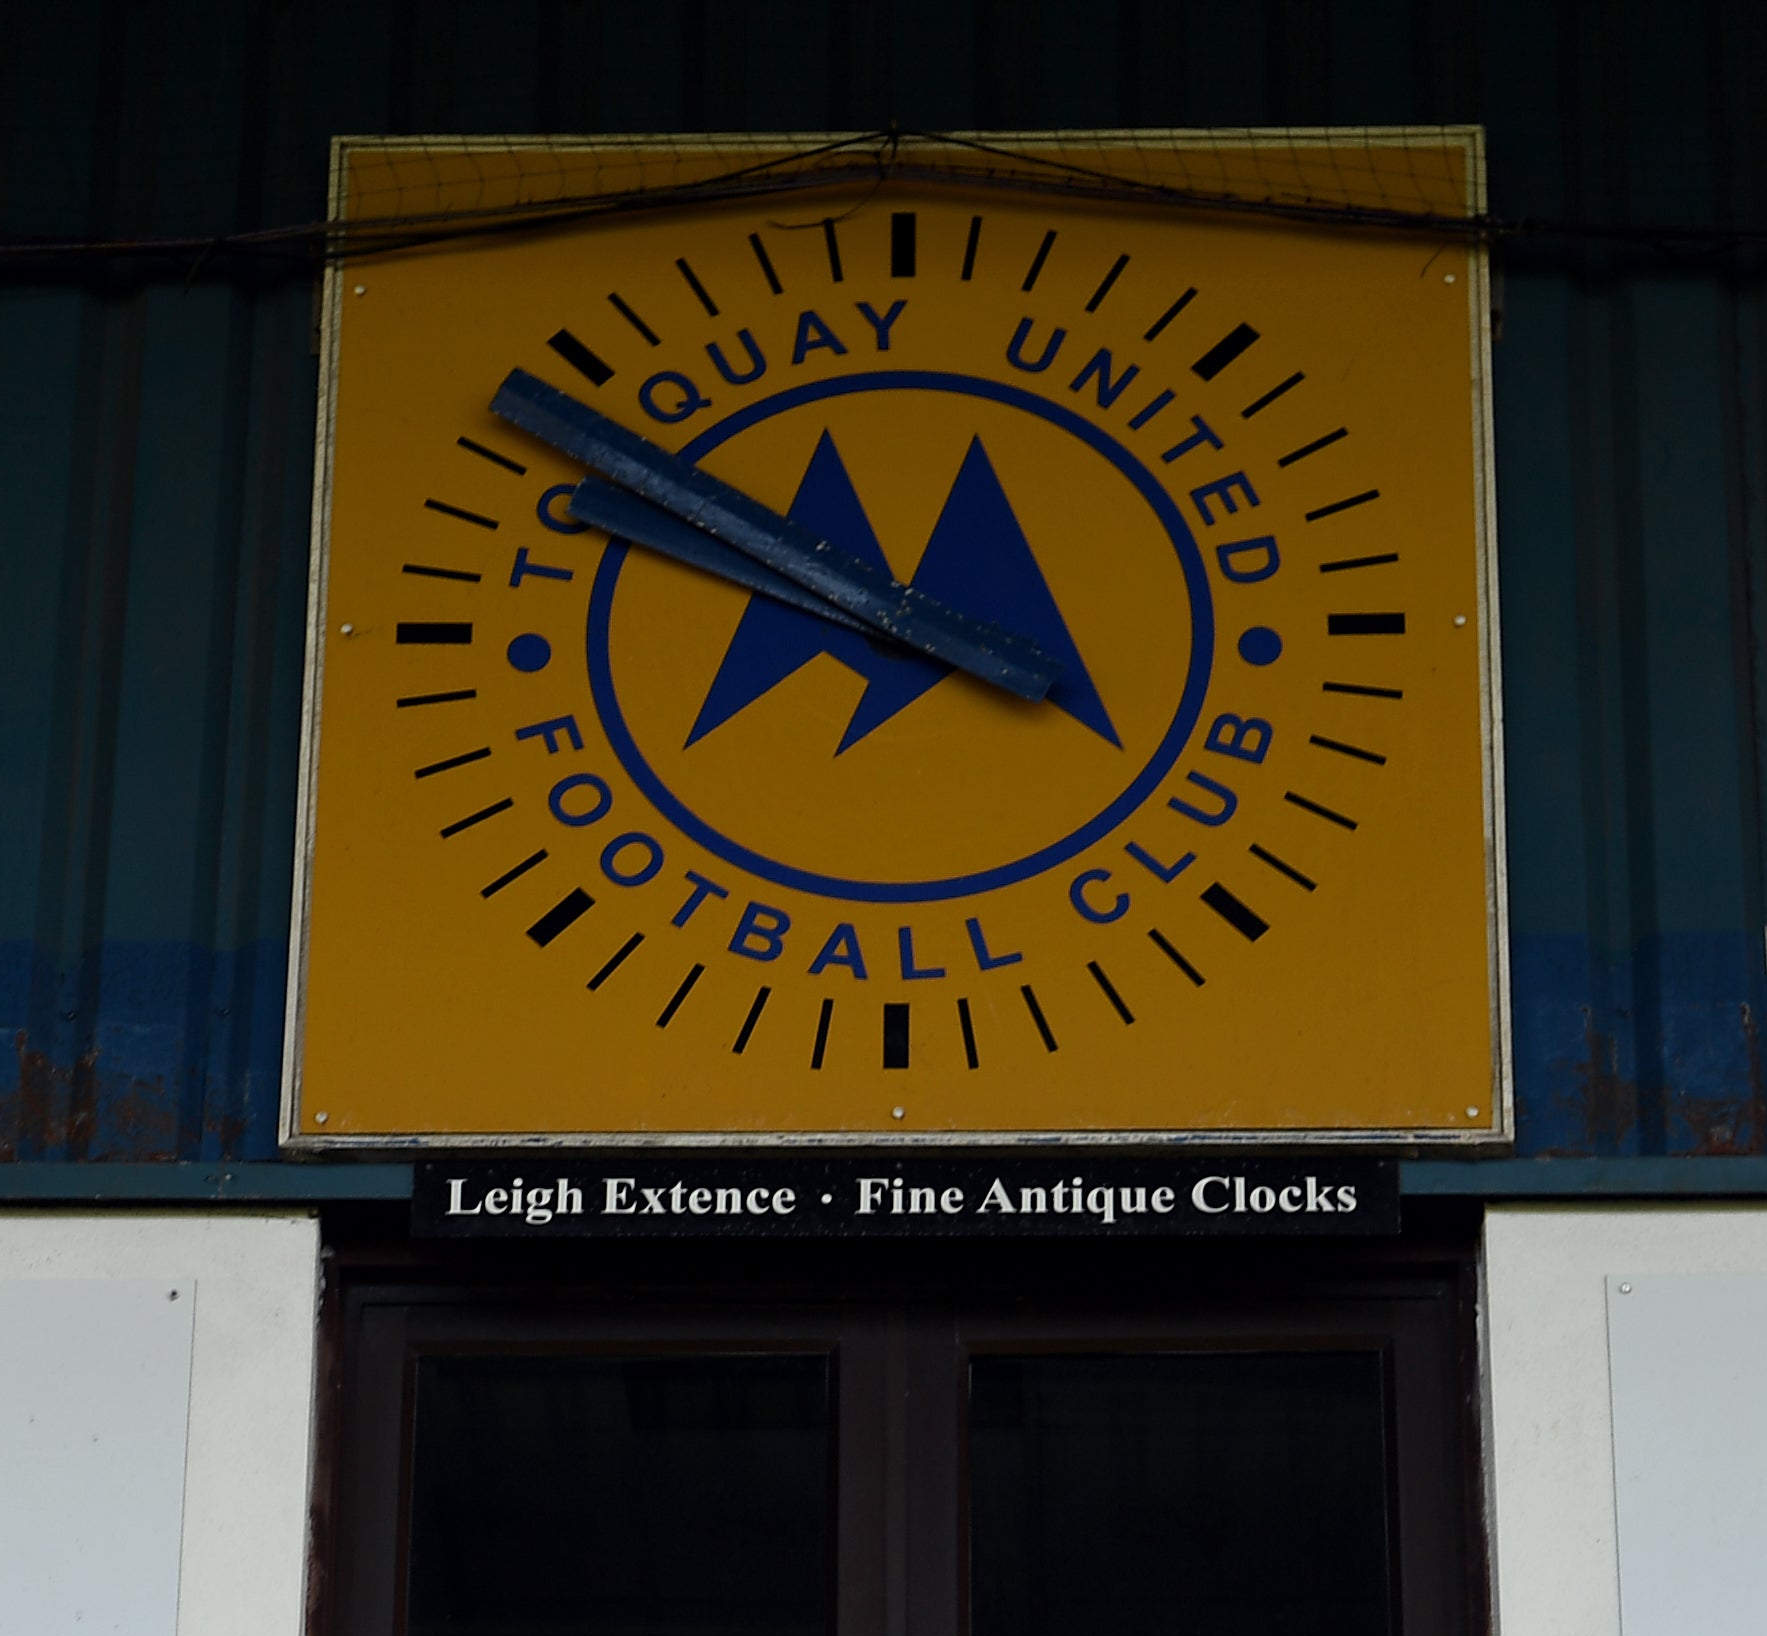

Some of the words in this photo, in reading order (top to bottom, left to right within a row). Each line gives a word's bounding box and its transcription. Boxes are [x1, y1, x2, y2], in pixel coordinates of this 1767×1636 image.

[509, 299, 910, 588] TOQUAY
[1004, 316, 1282, 584] UNITED
[514, 713, 1024, 982] FOOTBALL
[1068, 711, 1275, 924] CLUB
[445, 1177, 584, 1225] Leigh
[601, 1178, 797, 1215] Extence
[854, 1177, 965, 1215] Fine
[976, 1177, 1176, 1224] Antique
[1191, 1176, 1358, 1214] Clocks
